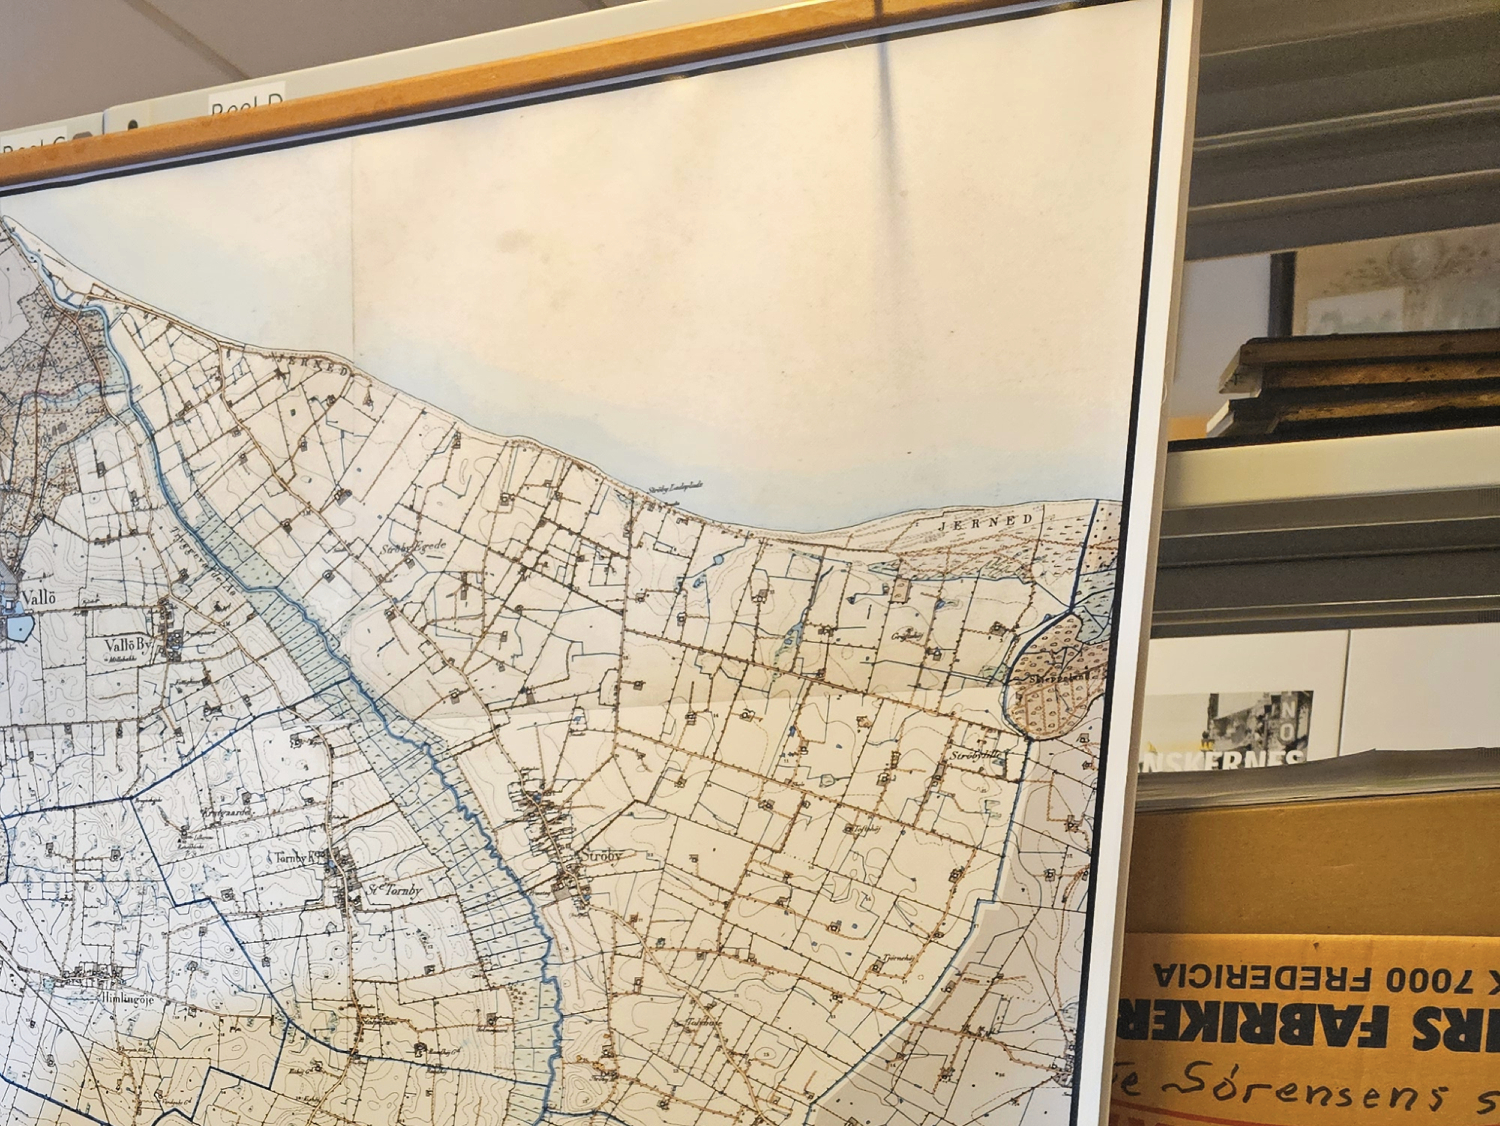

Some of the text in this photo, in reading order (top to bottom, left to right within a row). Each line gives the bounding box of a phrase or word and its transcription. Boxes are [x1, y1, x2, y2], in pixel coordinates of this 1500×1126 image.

[937, 513, 1033, 532] JERNED
[1153, 963, 1372, 992] FREDERICIA
[1386, 967, 1474, 995] 7000
